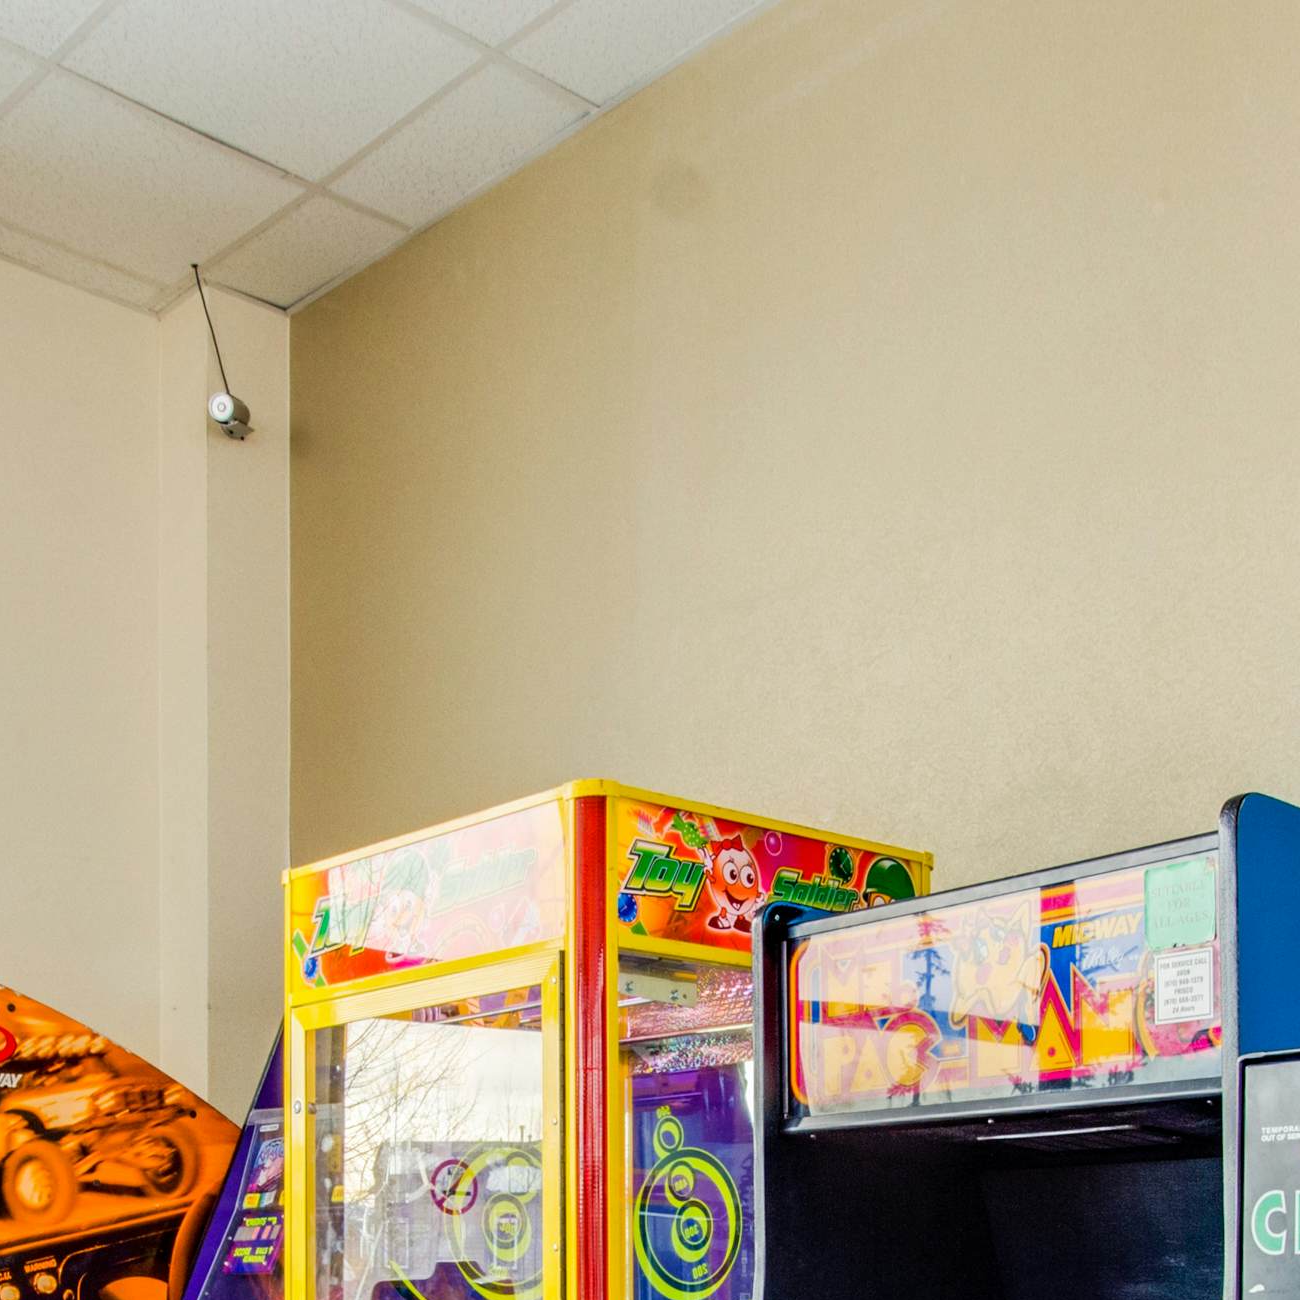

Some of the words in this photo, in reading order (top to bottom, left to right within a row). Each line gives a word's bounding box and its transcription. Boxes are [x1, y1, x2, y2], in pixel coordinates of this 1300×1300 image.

[626, 839, 706, 912] Toy
[771, 866, 860, 912] Soldier
[1152, 880, 1206, 897] SUITABLE
[1051, 912, 1143, 949] MIDWAY
[1154, 915, 1178, 929] ALL
[1184, 910, 1210, 924] AGES
[821, 975, 1136, 1097] PAC-MAN
[1261, 1134, 1276, 1143] OUT
[1276, 1133, 1286, 1141] OF
